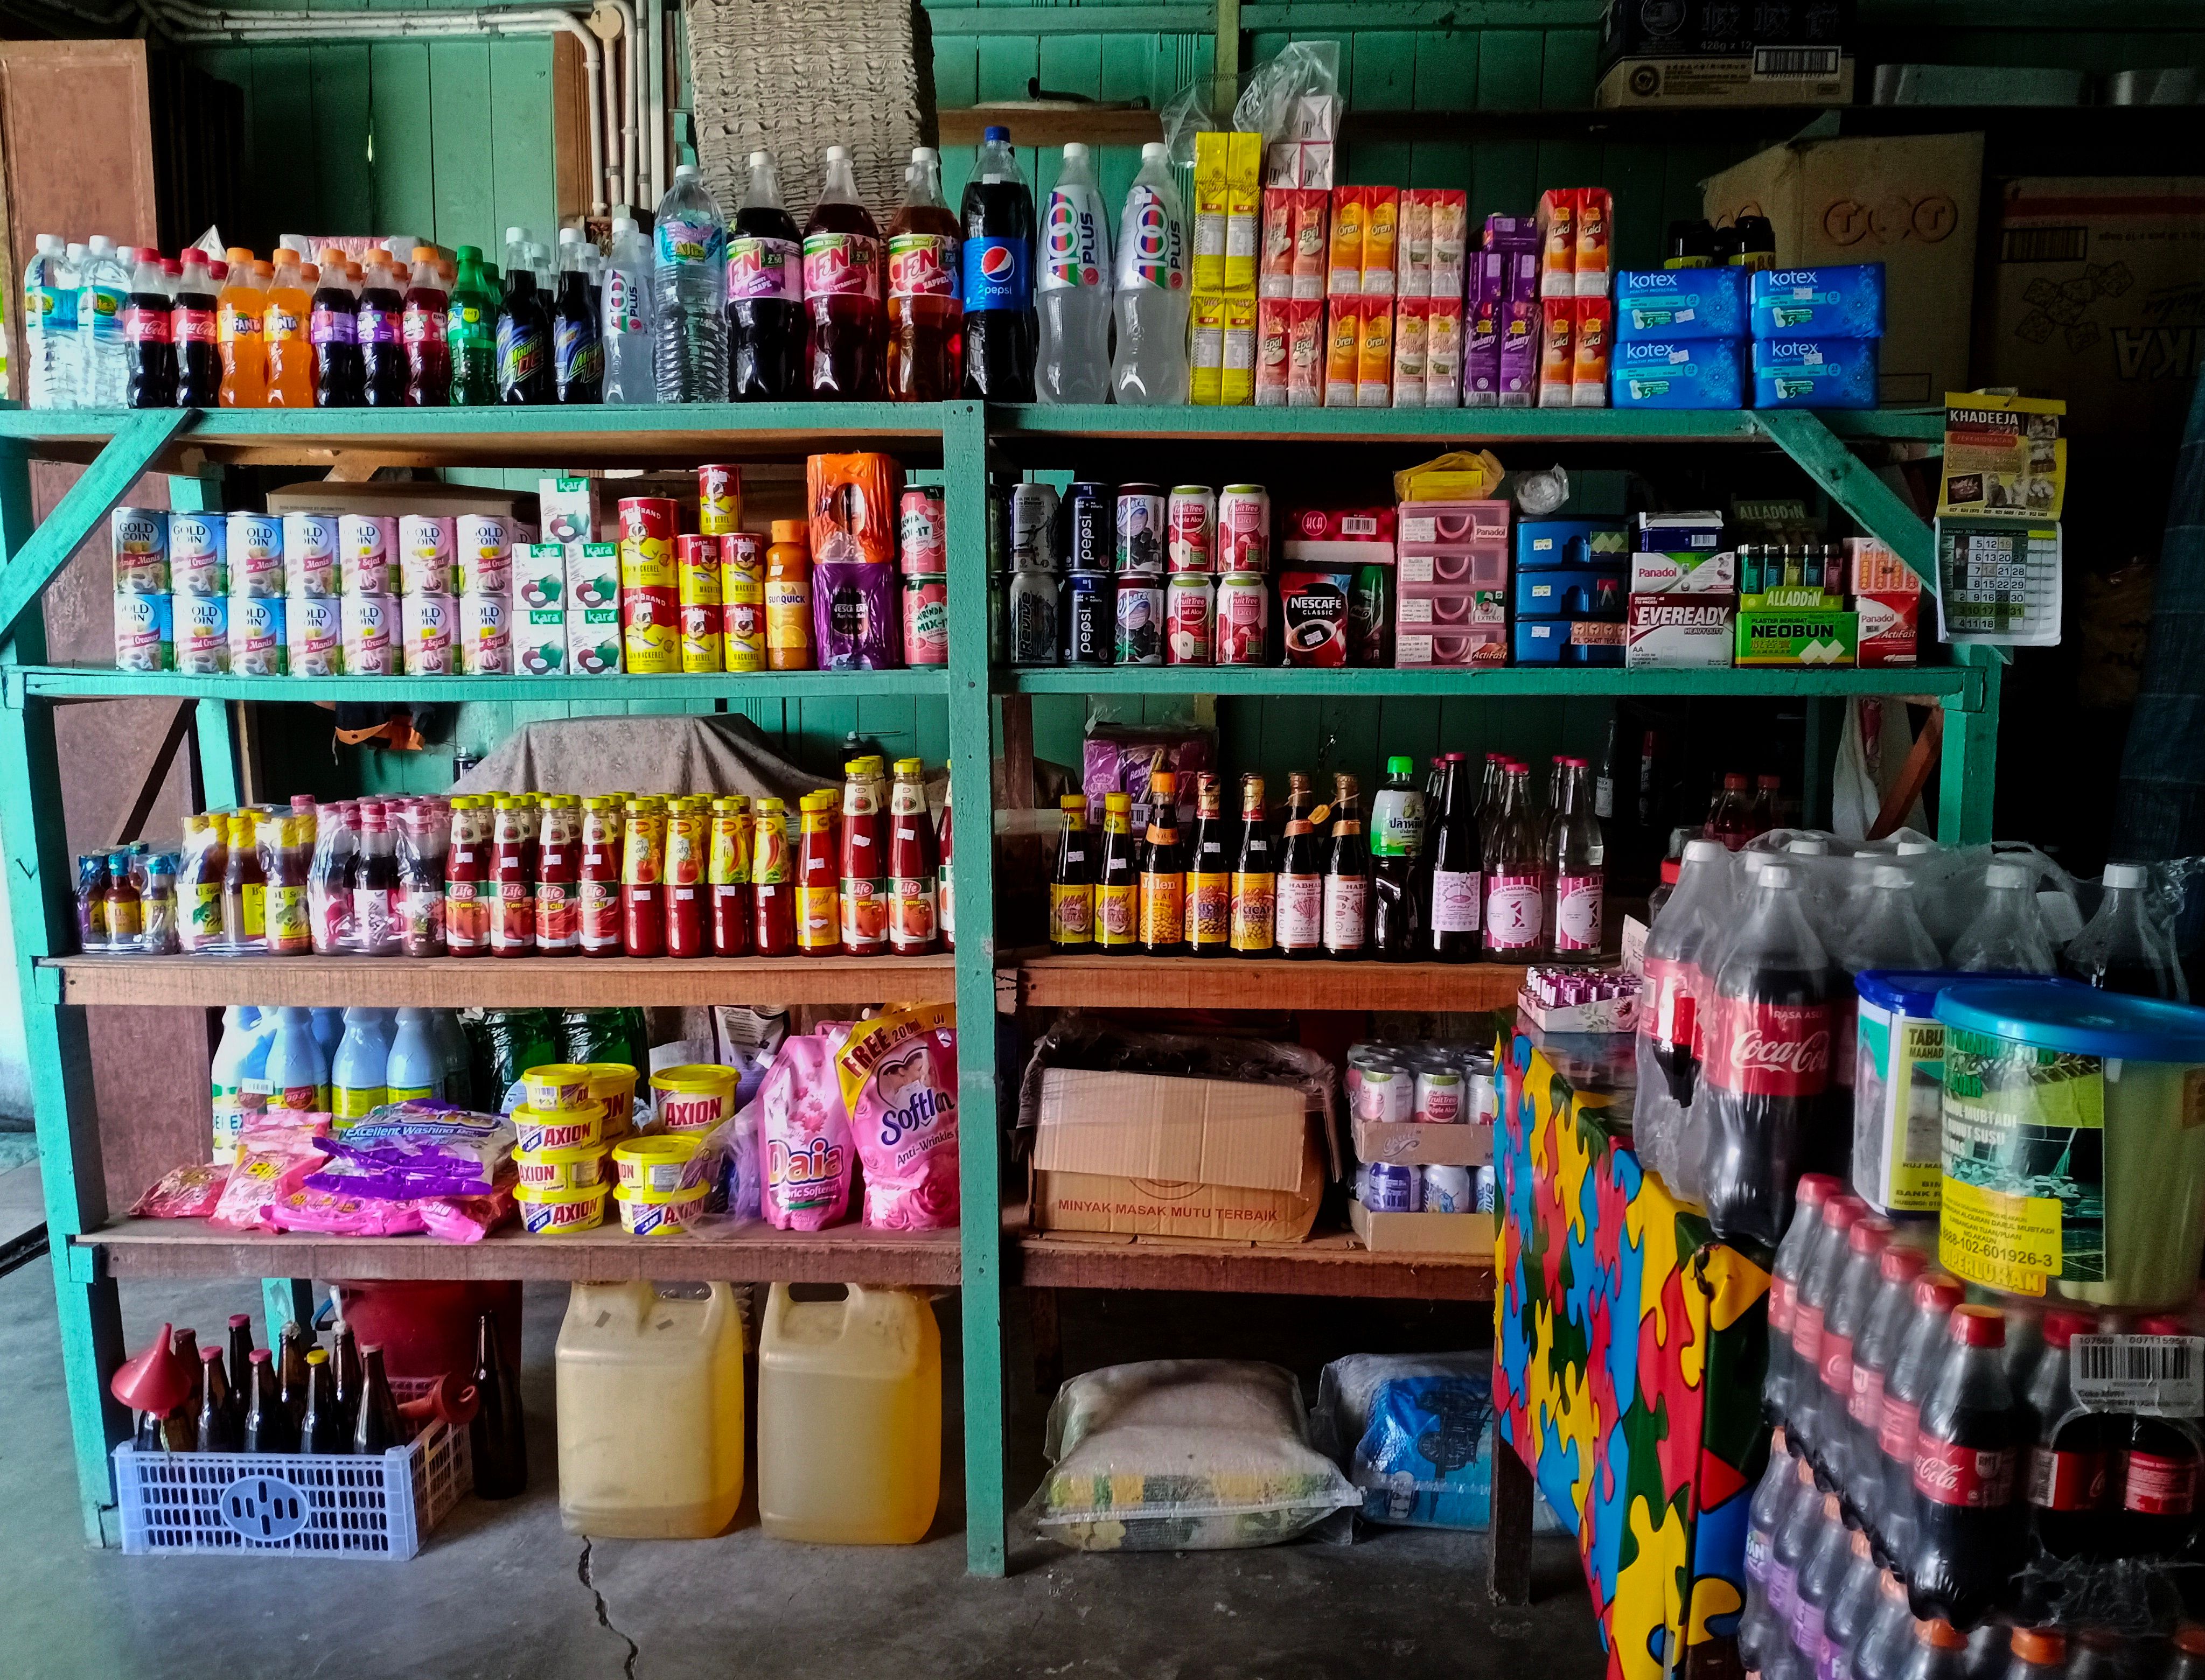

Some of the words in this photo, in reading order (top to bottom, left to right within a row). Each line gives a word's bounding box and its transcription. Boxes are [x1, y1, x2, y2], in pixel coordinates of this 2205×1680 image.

[1338, 225, 1357, 236] Oren
[1371, 224, 1391, 236] Oren
[1082, 212, 1095, 264] PLUS
[1170, 220, 1181, 270] PLUS
[1629, 271, 1677, 289] kotex
[1769, 270, 1818, 288] kotex
[985, 285, 1012, 296] pepsi
[629, 286, 638, 317] PLUS
[1335, 336, 1355, 348] Oren
[1365, 337, 1386, 349] Oren
[1773, 340, 1819, 358] kotex
[1627, 342, 1675, 358] kotex
[1950, 410, 2019, 425] KHADEEJA
[559, 478, 587, 492] kara
[119, 522, 154, 534] GOLD
[1476, 528, 1506, 537] Panadol
[122, 531, 150, 542] COIN
[1080, 513, 1095, 561] pepsi
[533, 543, 560, 557] kara
[585, 543, 613, 557] kara
[1976, 540, 1983, 548] 5
[1985, 540, 1997, 548] 12
[1975, 554, 1981, 562] 6
[1984, 554, 1997, 562] 13
[1638, 567, 1677, 578] Panadol
[1975, 566, 1980, 575] 7
[1997, 567, 2009, 575] 21
[2012, 568, 2025, 576] 28
[1983, 580, 1995, 588] 15
[1997, 580, 2009, 589] 22
[2011, 581, 2023, 589] 29
[1973, 593, 1979, 601] 9
[1983, 593, 1994, 601] 16
[2011, 594, 2023, 603] 30
[532, 610, 560, 625] kara
[588, 610, 615, 624] kara
[1637, 607, 1730, 626] EVEREADY
[1861, 613, 1894, 623] Panadol
[2010, 607, 2022, 615] 31
[1080, 607, 1094, 653] pepsi
[1959, 619, 1965, 627] 4
[1967, 619, 1978, 627] 11
[1981, 620, 1993, 628] 18
[1684, 627, 1706, 635] HEAVY
[1750, 625, 1834, 639] NEOBUN
[1881, 629, 1916, 639] ActiFast
[1472, 650, 1507, 660] ActiFast
[454, 885, 473, 897] Life
[502, 884, 523, 897] Life
[1774, 1010, 1802, 1019] RASA
[841, 1026, 892, 1079] FREE
[1908, 1046, 1944, 1058] MAAHAD
[666, 1096, 722, 1126] AXION
[345, 1126, 401, 1138] Excellent
[543, 1122, 591, 1147] AXION
[1974, 1127, 2006, 1146] SUSU
[897, 1130, 955, 1168] Anti-Wrinkles
[769, 1139, 844, 1187] Daia
[519, 1164, 555, 1182] AXION
[804, 1184, 837, 1197] Softener
[552, 1197, 598, 1225] AXION
[1058, 1199, 1112, 1213] MINYAK
[1115, 1203, 1167, 1216] MASAK
[1171, 1207, 1211, 1219] MUTU
[1215, 1208, 1278, 1221] TERBAIK
[1991, 1219, 2016, 1230] DARUL
[2016, 1223, 2055, 1235] MUBTADI
